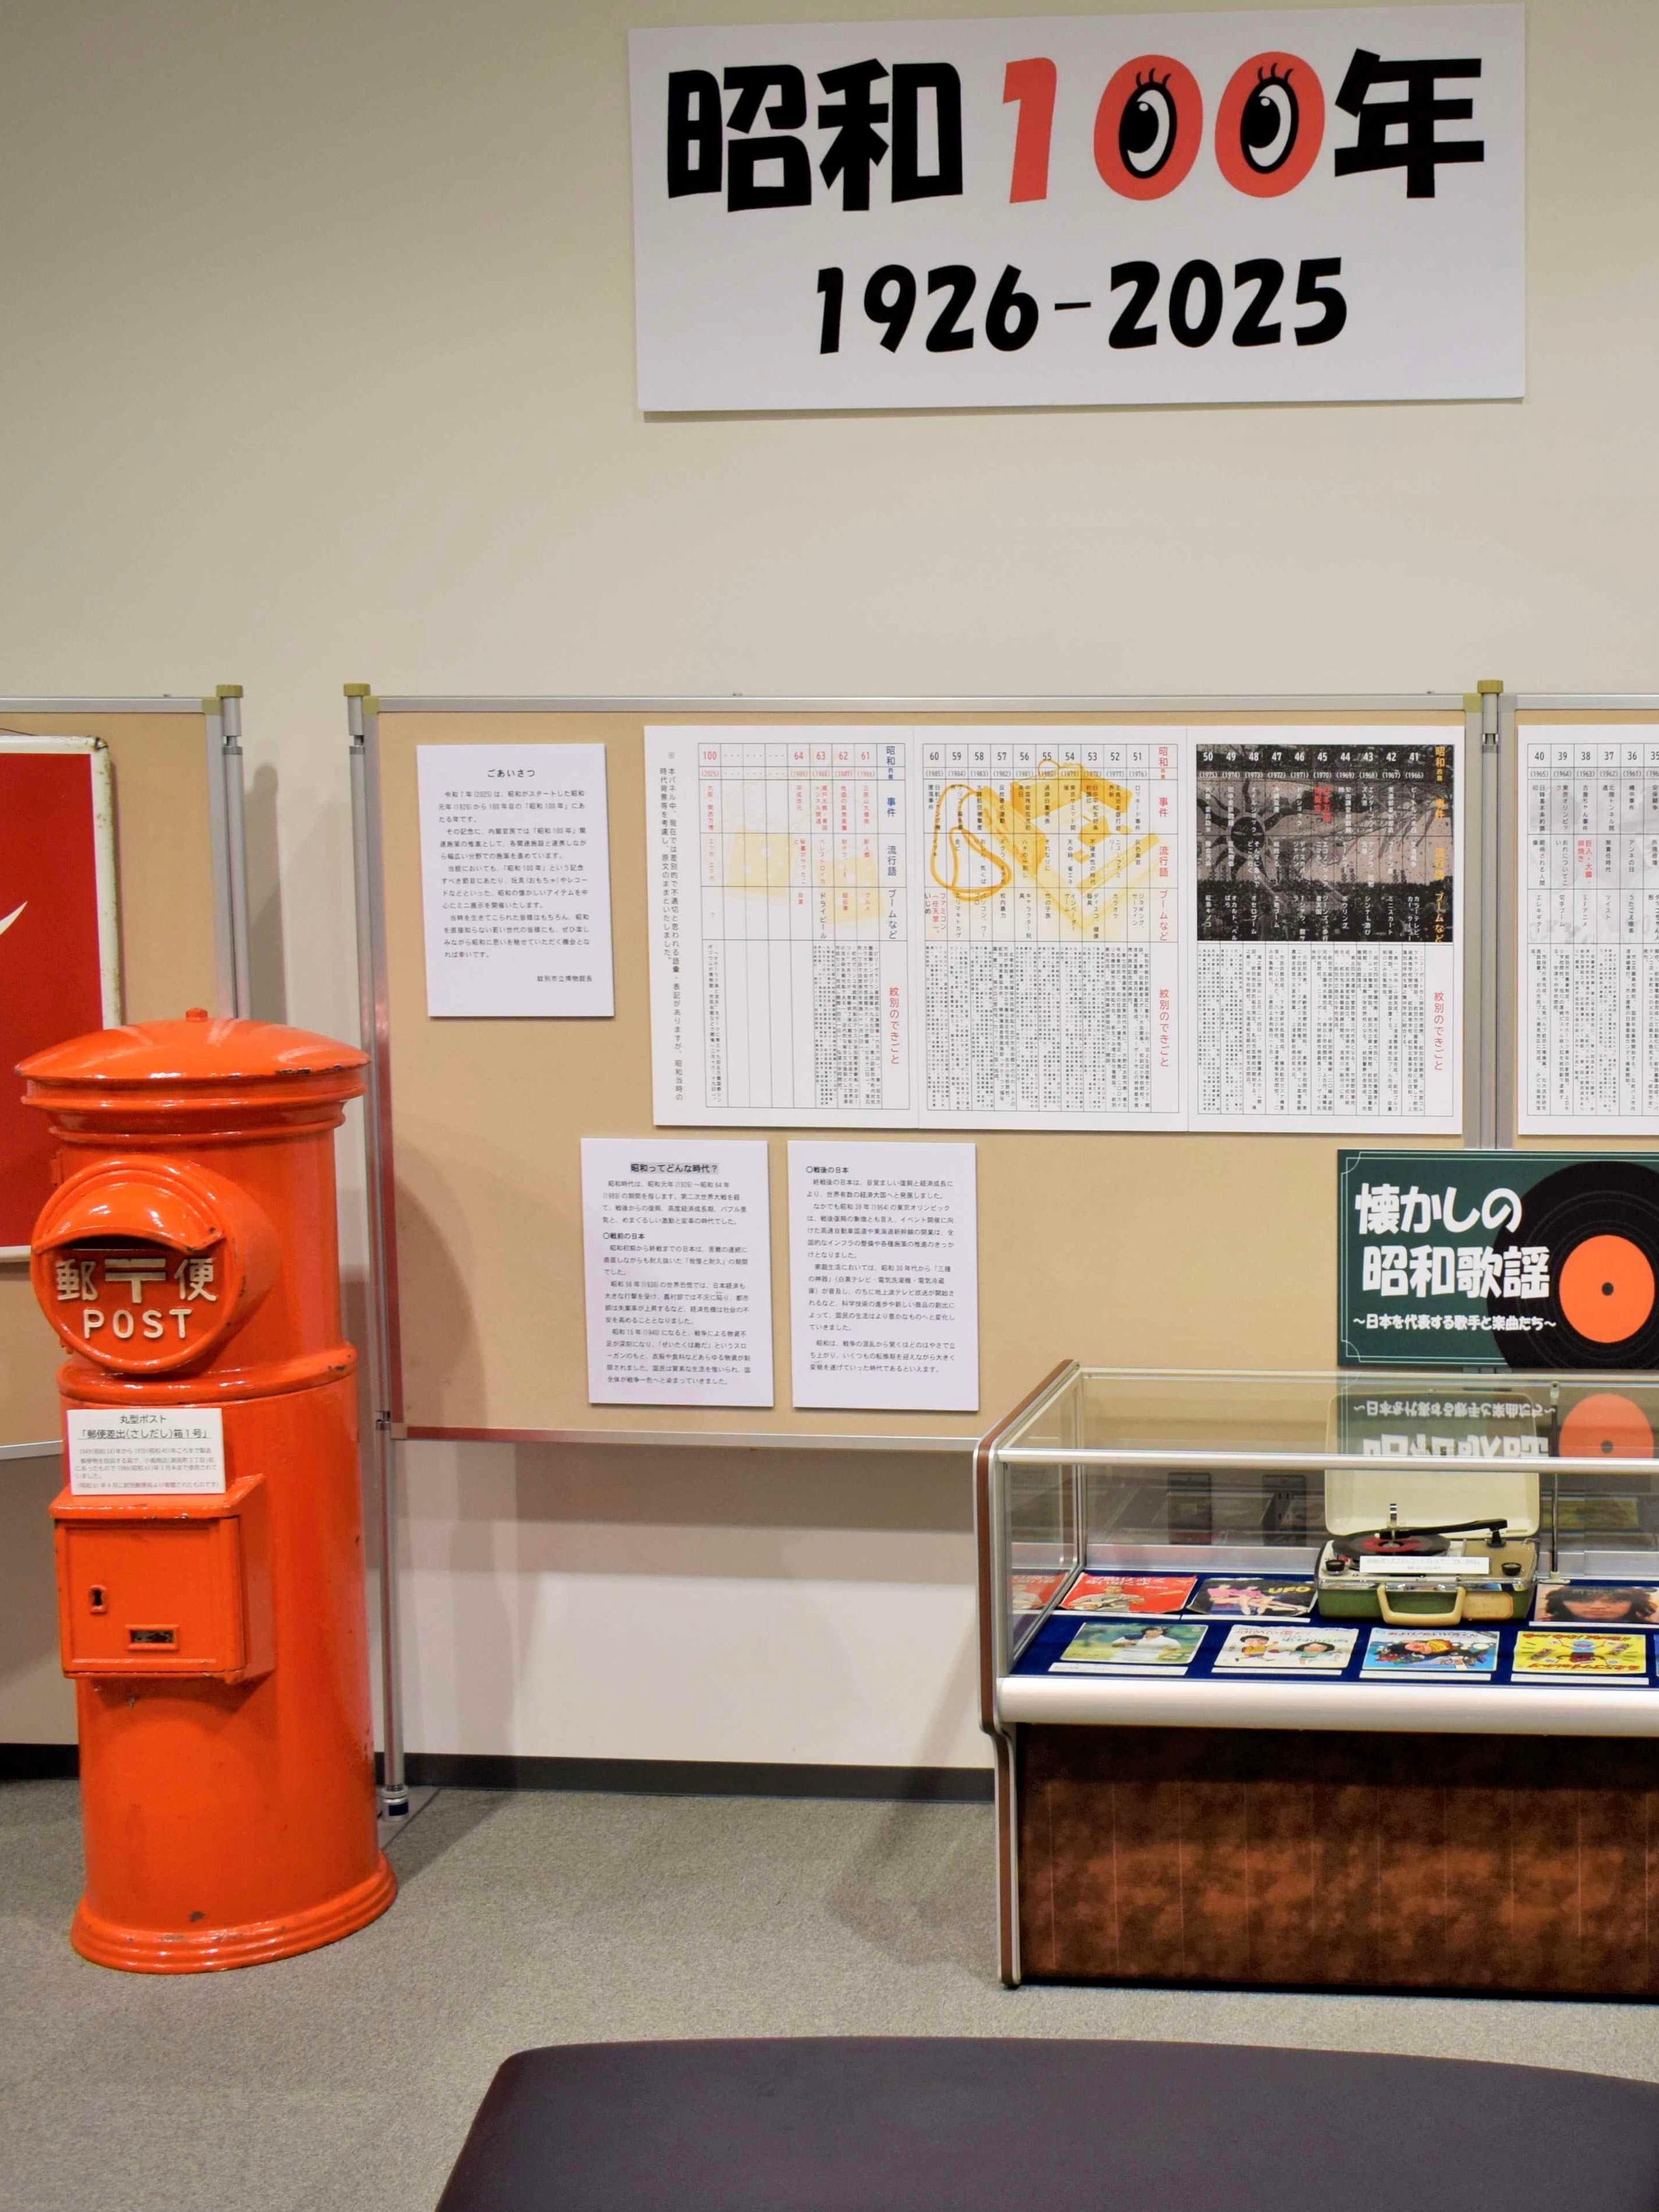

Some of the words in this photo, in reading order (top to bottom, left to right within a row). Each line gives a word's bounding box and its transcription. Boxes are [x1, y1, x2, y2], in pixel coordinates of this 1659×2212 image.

[668, 48, 1485, 212] 昭和100年
[703, 751, 716, 759] 100
[794, 751, 803, 759] 64
[816, 751, 825, 759] 63
[887, 746, 895, 765] 昭和
[930, 752, 939, 760] 60
[952, 752, 961, 760] 59
[975, 752, 984, 761] 58
[997, 753, 1006, 761] 57
[1020, 752, 1029, 761] 56
[1043, 753, 1051, 761] 55
[1065, 753, 1075, 761] 54
[1088, 753, 1097, 761] 53
[1111, 753, 1120, 761] 52
[1134, 753, 1142, 761] 51
[1159, 747, 1168, 766] 昭和
[1203, 753, 1213, 761] 50
[1227, 753, 1236, 761] 49
[1249, 753, 1259, 761] 48
[1272, 753, 1282, 761] 47
[1295, 753, 1305, 761] 46
[1317, 753, 1327, 761] 45
[1340, 753, 1350, 761] 44
[1364, 753, 1373, 761] 43
[1386, 753, 1396, 761] 42
[1409, 753, 1419, 761] 41
[1435, 746, 1445, 767] 昭和
[1535, 752, 1544, 761] 40
[1558, 752, 1567, 761] 39
[1581, 752, 1591, 761] 38
[1605, 752, 1614, 760] 37
[1628, 752, 1637, 760] 36
[487, 769, 535, 777] ごあいさつ
[887, 798, 896, 817] 事件
[1160, 798, 1168, 817] 事件
[887, 846, 897, 876] 流行語
[1160, 846, 1168, 877] 流行語
[888, 890, 897, 938] ブームなど
[1160, 891, 1168, 940] ブームなど
[1435, 892, 1445, 943] ブームなど
[889, 987, 899, 1065] 紋別のできごと
[1159, 988, 1170, 1068] 紋別のできごと
[1434, 991, 1445, 1070] 紋別のできごと
[1354, 1183, 1523, 1235] 懐かしの
[1362, 1244, 1550, 1299] 昭和歌謡
[83, 1309, 193, 1339] POST
[120, 1415, 167, 1424] 丸型ポスト
[1268, 1585, 1312, 1594] UFO
